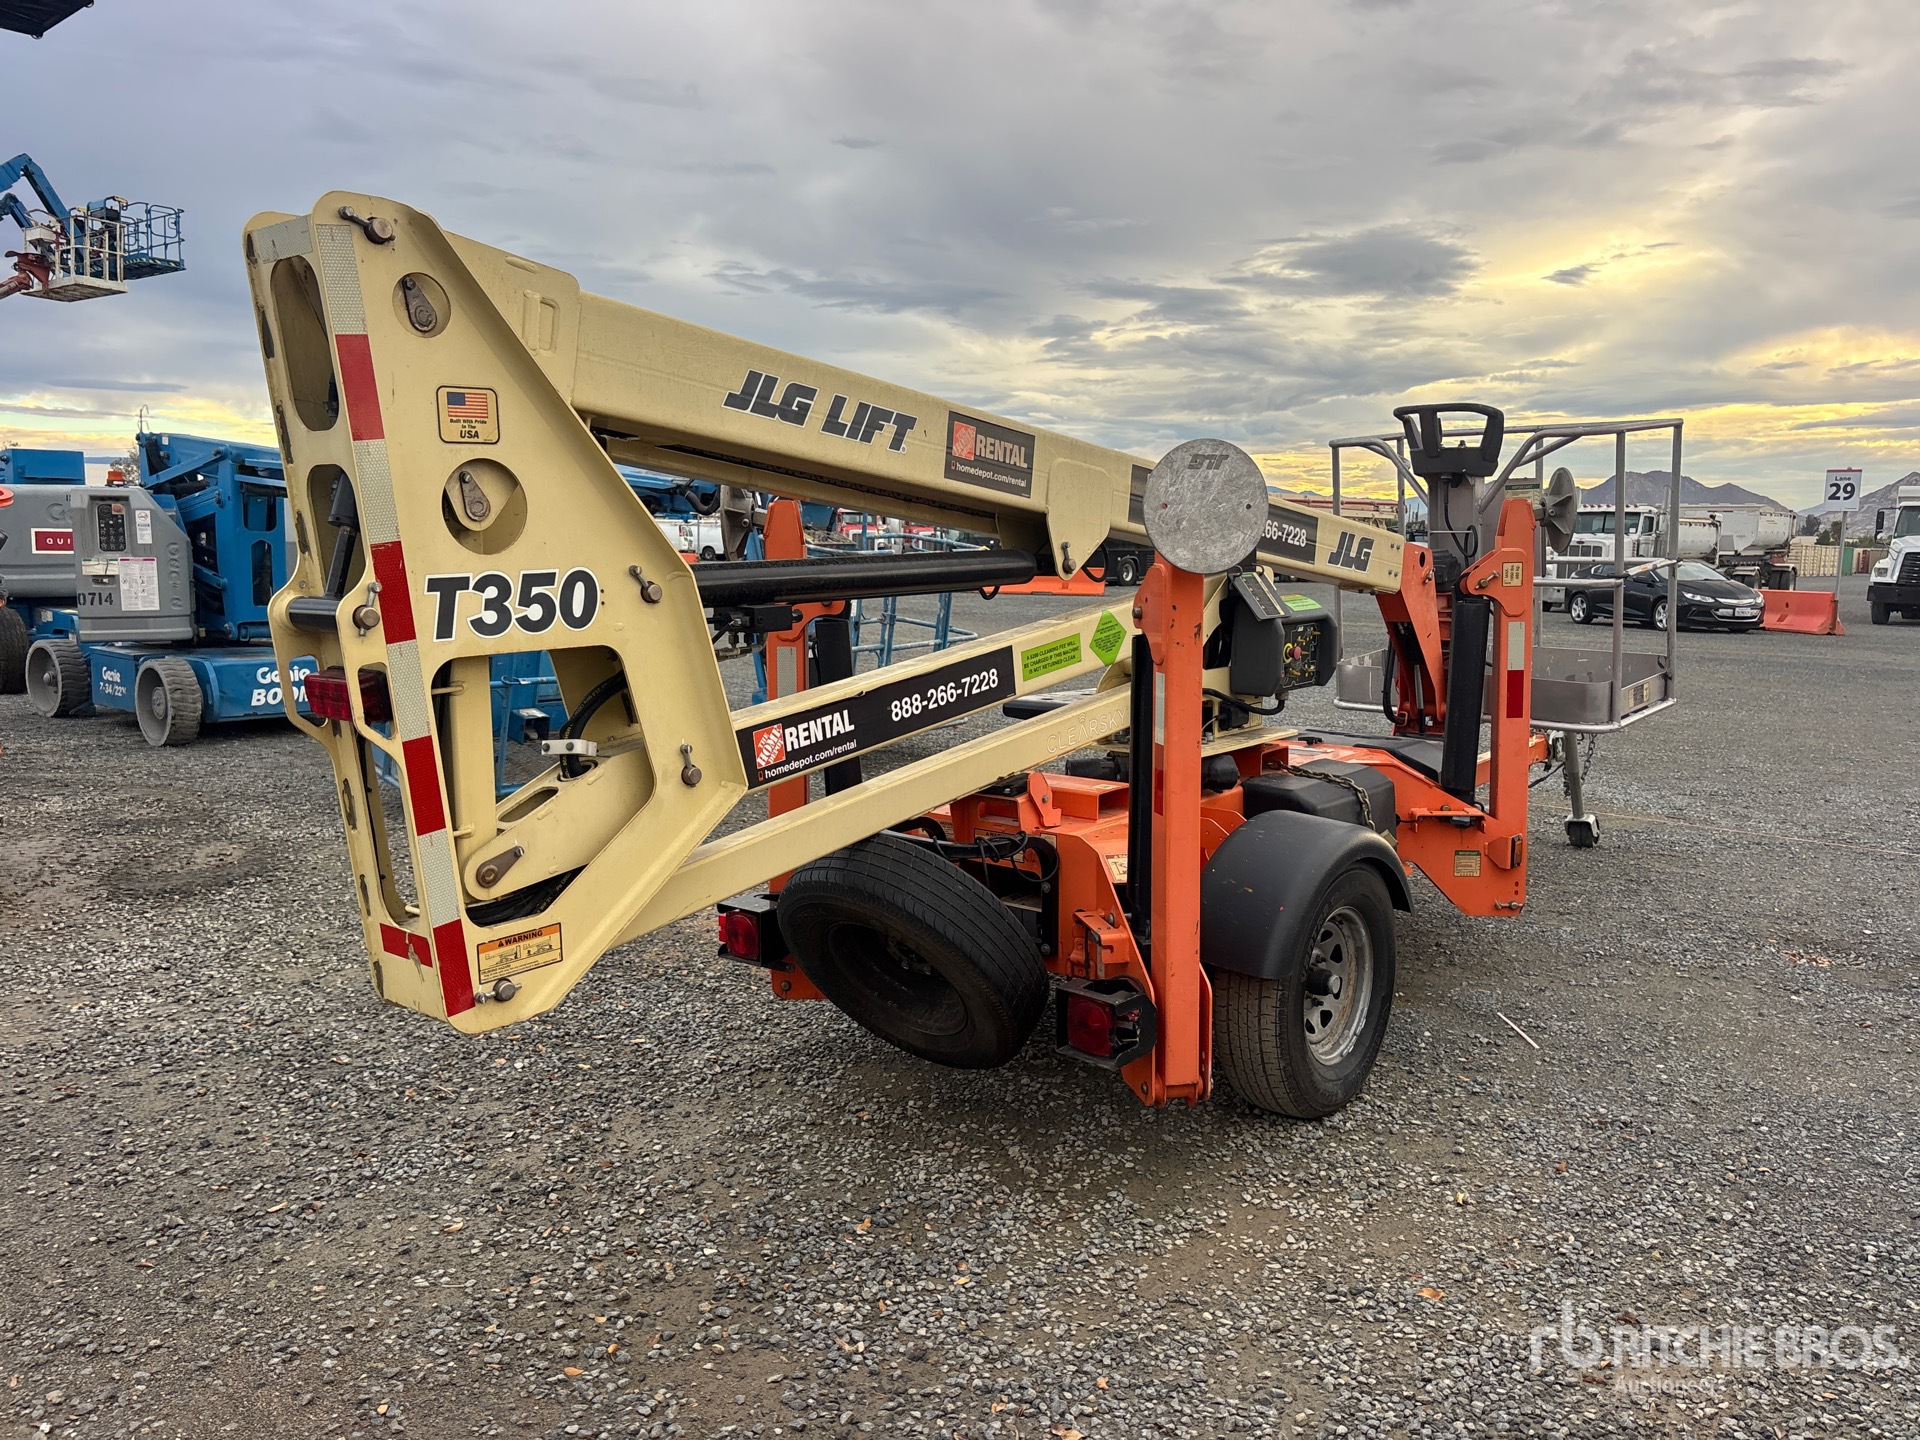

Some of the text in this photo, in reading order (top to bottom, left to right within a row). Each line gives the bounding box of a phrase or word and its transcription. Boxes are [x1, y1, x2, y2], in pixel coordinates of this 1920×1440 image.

[721, 368, 918, 452] JLG LIFT
[460, 430, 479, 439] USA
[976, 434, 1027, 468] RENTAL
[956, 463, 1026, 487] homedepot.com/rental
[1828, 482, 1855, 500] 29
[1262, 520, 1306, 548] 66-7228
[1327, 531, 1375, 574] JLG
[78, 592, 113, 606] 0714
[424, 566, 599, 642] T350
[1030, 656, 1049, 666] CHARGED
[1039, 646, 1058, 656] CLEANING
[1042, 659, 1062, 669] RETURNED
[891, 668, 998, 721] 888-266-7228
[758, 732, 769, 748] THE
[784, 710, 855, 752] RENTAL
[1047, 705, 1129, 753] CLEARSKY
[757, 725, 782, 767] HOME
[765, 739, 857, 779] homedepot.com/rental
[768, 740, 784, 764] DEPOT
[505, 930, 543, 945] WARNING
